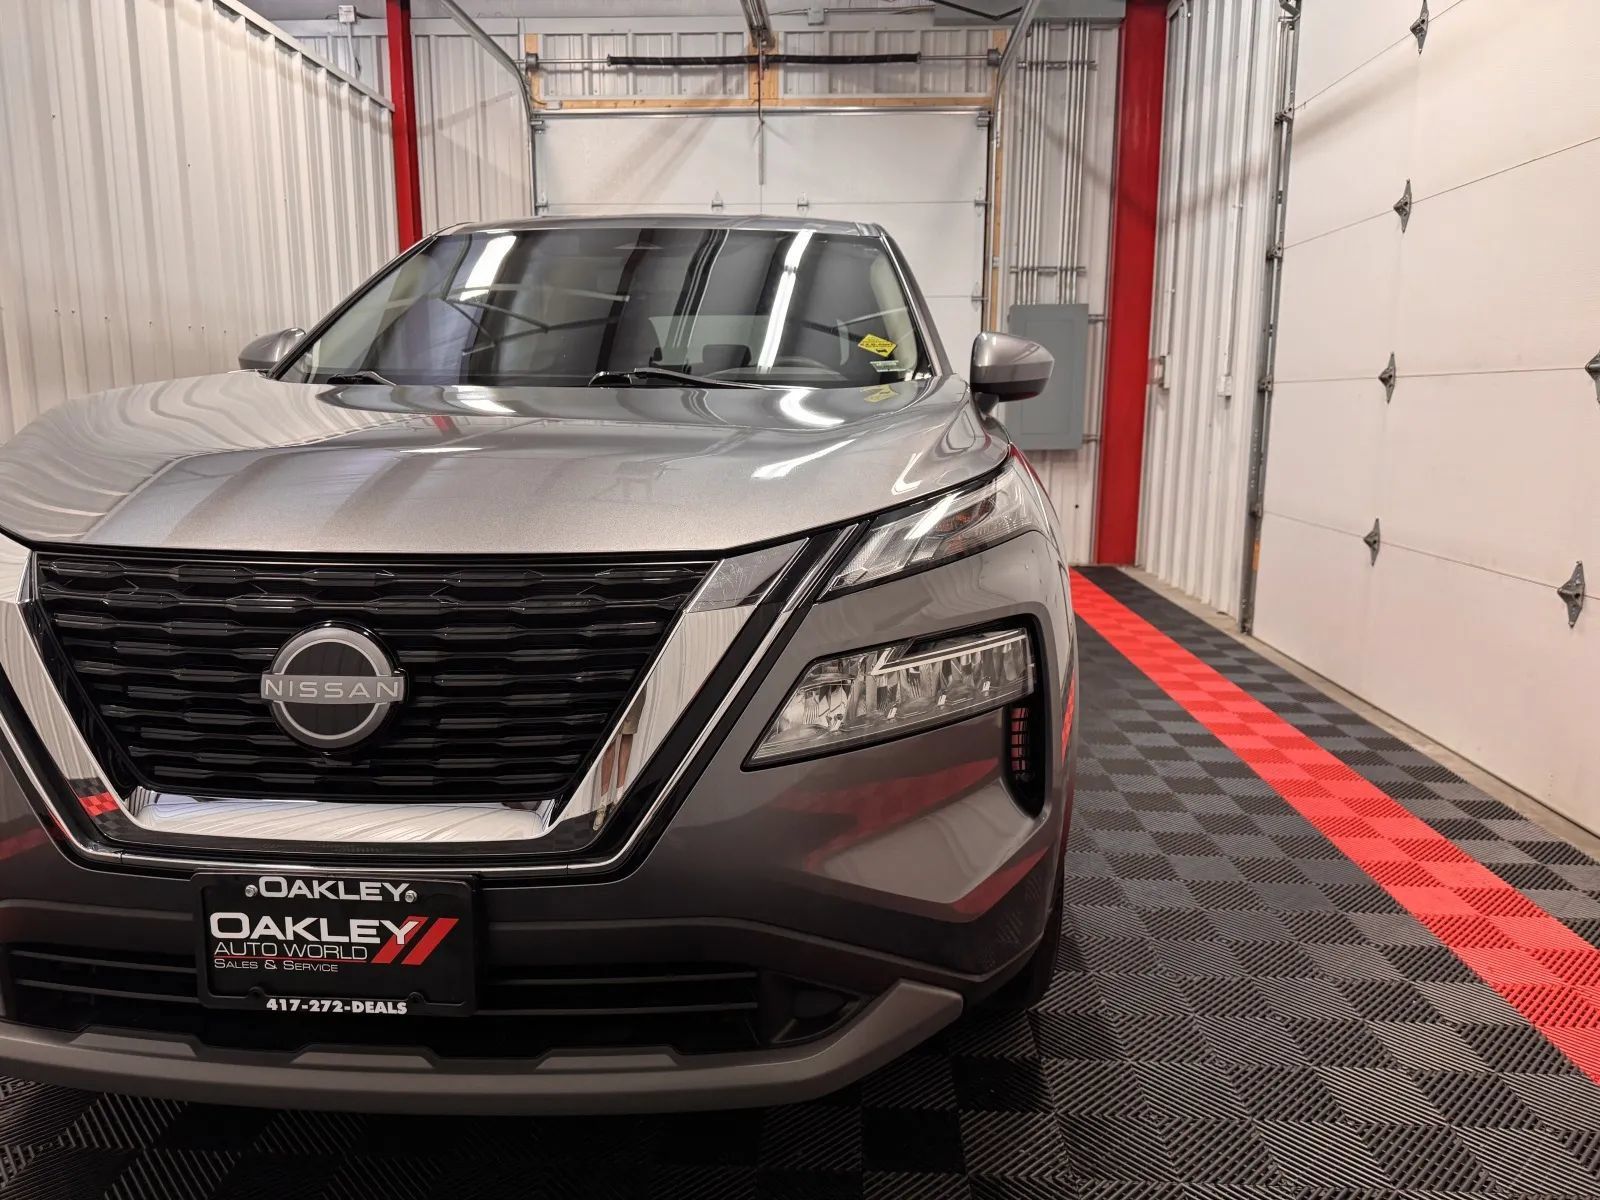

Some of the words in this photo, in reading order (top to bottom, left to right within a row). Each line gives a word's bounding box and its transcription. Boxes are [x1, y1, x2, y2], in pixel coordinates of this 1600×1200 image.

[264, 679, 398, 698] NISSAN
[259, 876, 410, 902] OAKLEY
[209, 912, 419, 945] OAKLEY
[214, 941, 278, 957] AUTO
[283, 943, 368, 960] WORLD
[214, 958, 258, 969] SALES
[264, 959, 278, 970] &
[283, 960, 338, 972] SERVICE
[266, 998, 408, 1015] 417-272-DEALS
